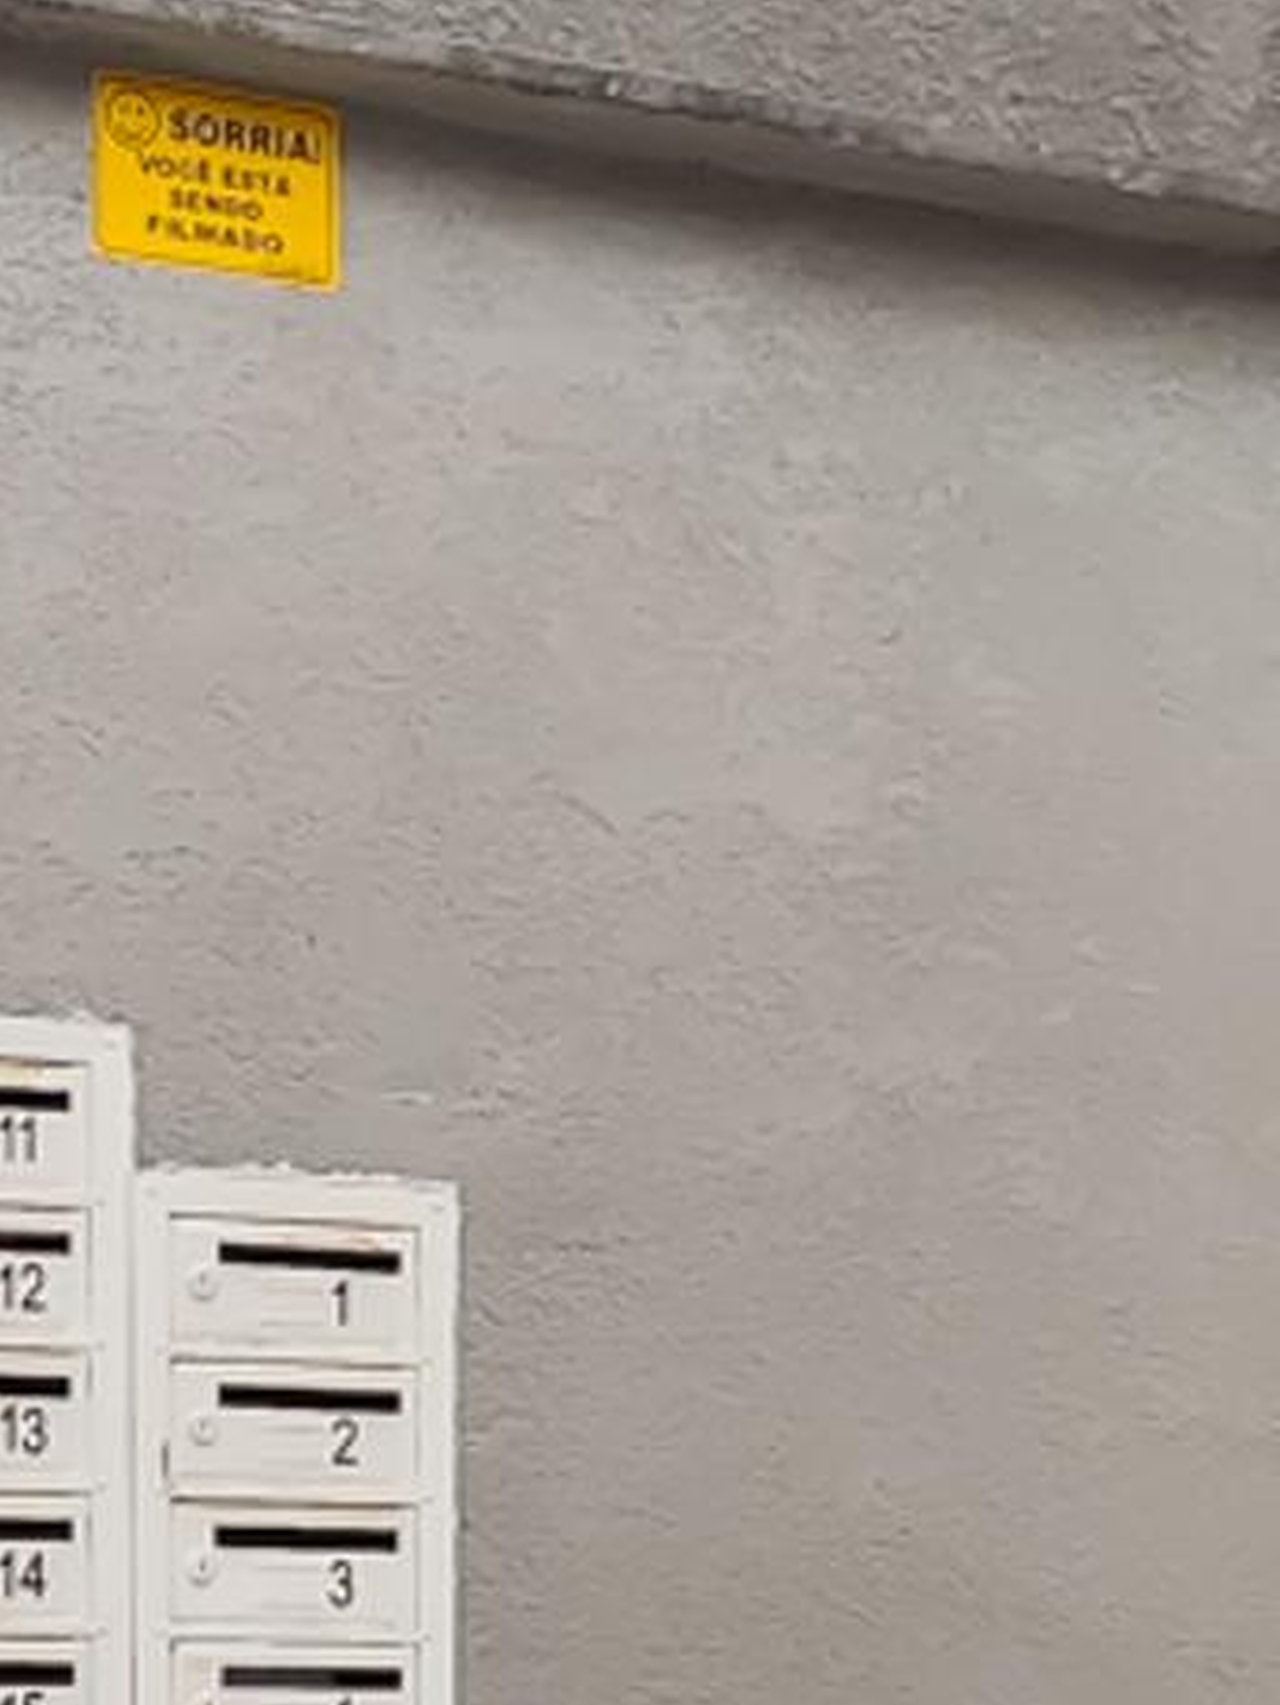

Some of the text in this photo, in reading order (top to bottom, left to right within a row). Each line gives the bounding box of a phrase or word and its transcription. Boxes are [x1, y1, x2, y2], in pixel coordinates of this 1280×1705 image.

[170, 188, 264, 221] SENDO
[146, 215, 284, 253] FILMADO
[0, 1262, 44, 1312] 12
[333, 1281, 348, 1325] 1
[0, 1405, 47, 1455] 13
[333, 1419, 358, 1466] 2
[0, 1551, 45, 1597] 14
[330, 1559, 353, 1608] 3
